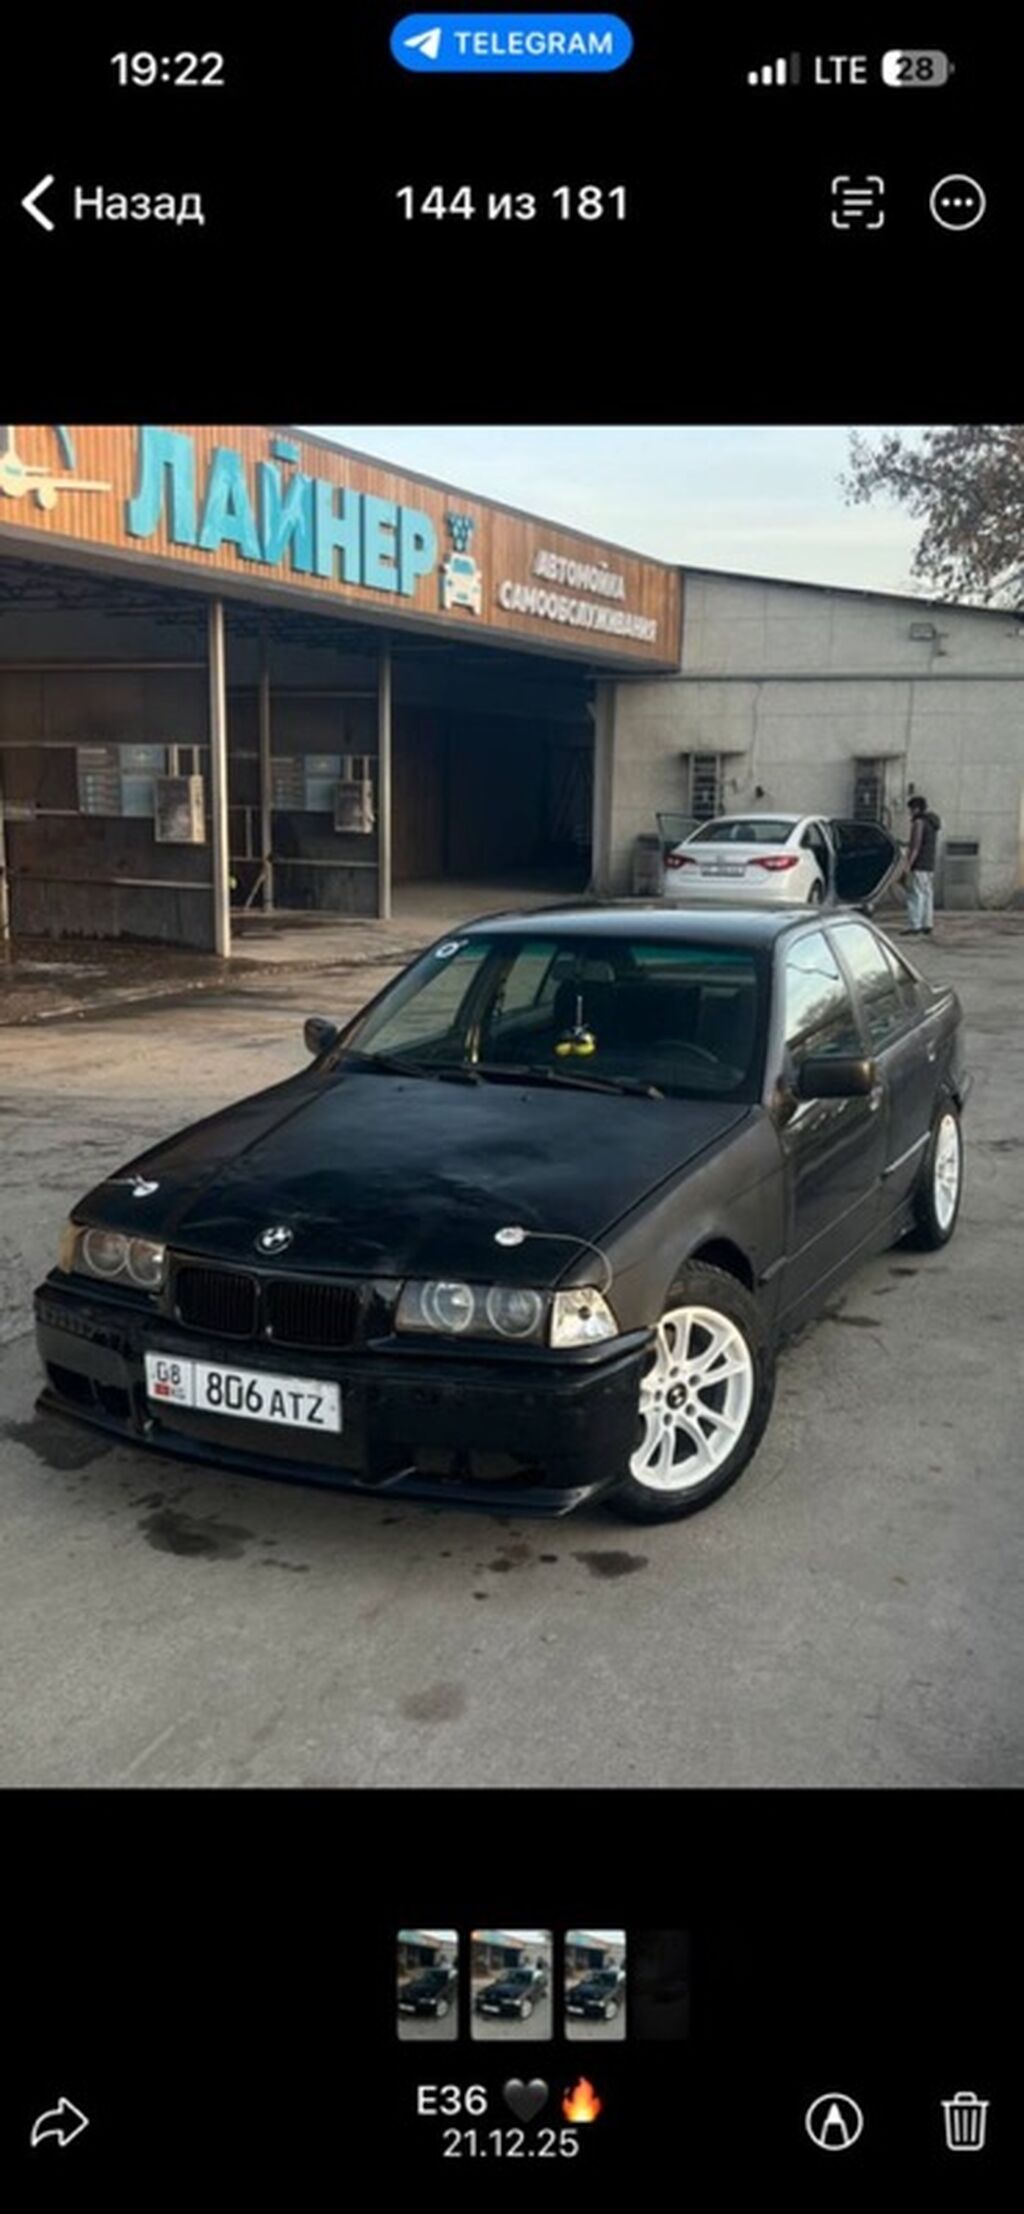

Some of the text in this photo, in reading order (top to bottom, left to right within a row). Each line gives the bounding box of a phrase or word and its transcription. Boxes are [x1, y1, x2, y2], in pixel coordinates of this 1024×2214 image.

[129, 425, 438, 597] ЛАЙНЕР
[205, 1371, 263, 1413] 806
[269, 1389, 324, 1424] ATZ
